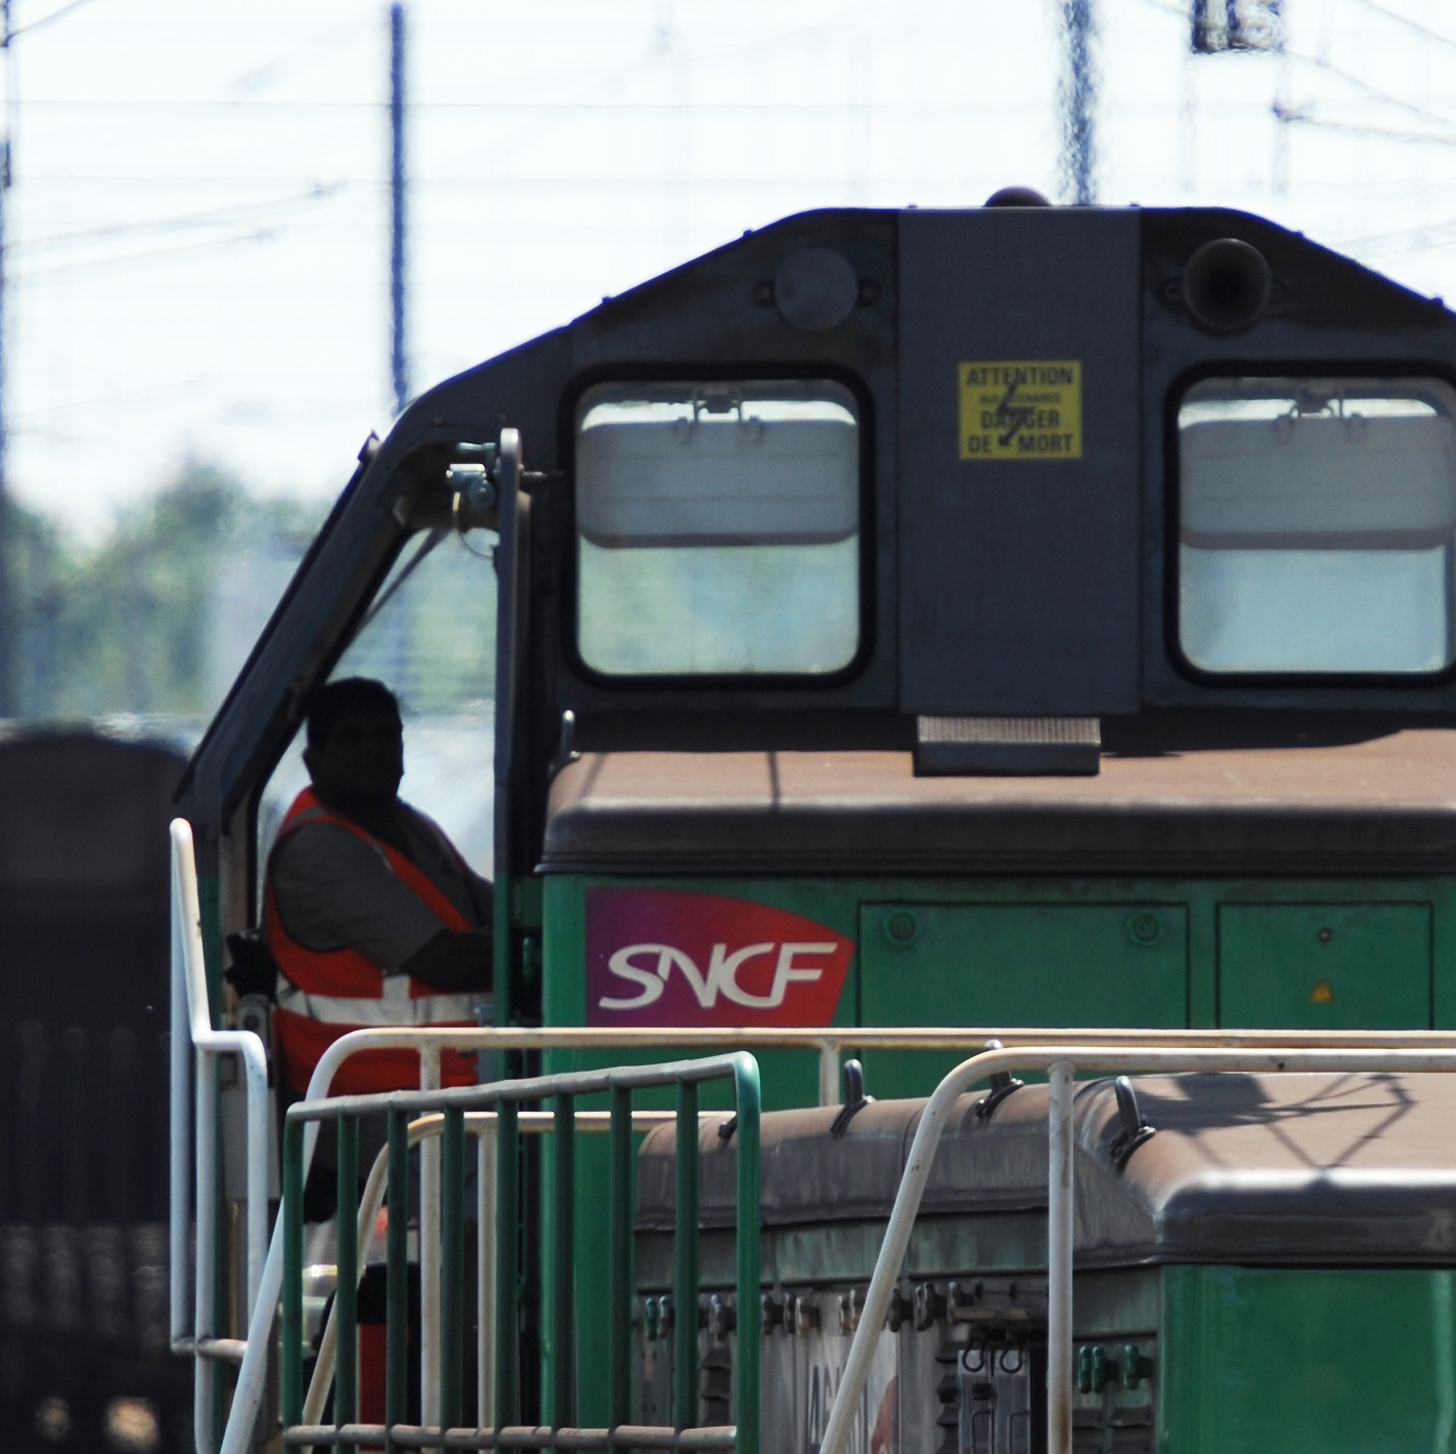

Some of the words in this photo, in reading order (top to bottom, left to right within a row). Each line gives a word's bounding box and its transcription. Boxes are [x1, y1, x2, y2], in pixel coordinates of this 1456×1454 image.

[966, 366, 1073, 386] ATTENTION
[968, 434, 992, 453] DE
[1017, 434, 1074, 452] MORT
[599, 942, 838, 1010] SNCF
